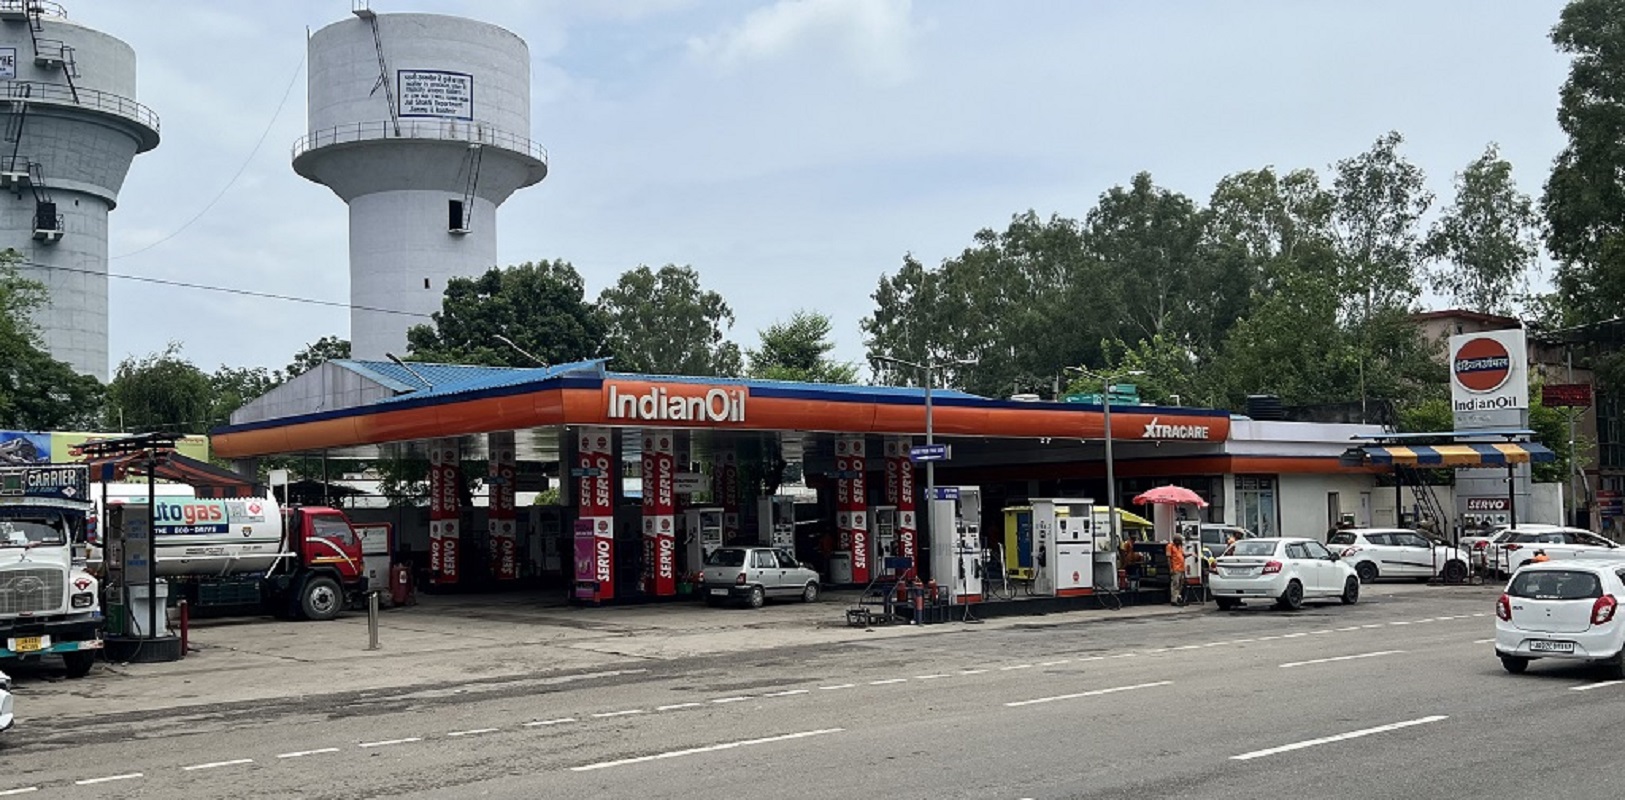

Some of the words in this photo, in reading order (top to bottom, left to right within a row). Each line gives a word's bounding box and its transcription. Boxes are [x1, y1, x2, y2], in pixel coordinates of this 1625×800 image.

[608, 385, 745, 422] IndianOil
[1454, 396, 1517, 411] IndianOil
[1142, 417, 1209, 439] XTRACARE
[28, 469, 76, 487] CARRIER
[444, 468, 455, 512] SERVO
[581, 459, 591, 507] SERO
[644, 459, 654, 507] SERVO
[660, 458, 671, 507] SERVO
[838, 460, 848, 504] SERO
[902, 461, 912, 504] SERVO
[1468, 499, 1505, 510] SERVO
[444, 540, 455, 576] SERVO
[501, 540, 513, 575] SERVO
[597, 541, 610, 582] SERVO
[660, 539, 672, 579] SERVO
[855, 532, 866, 569] SERVO
